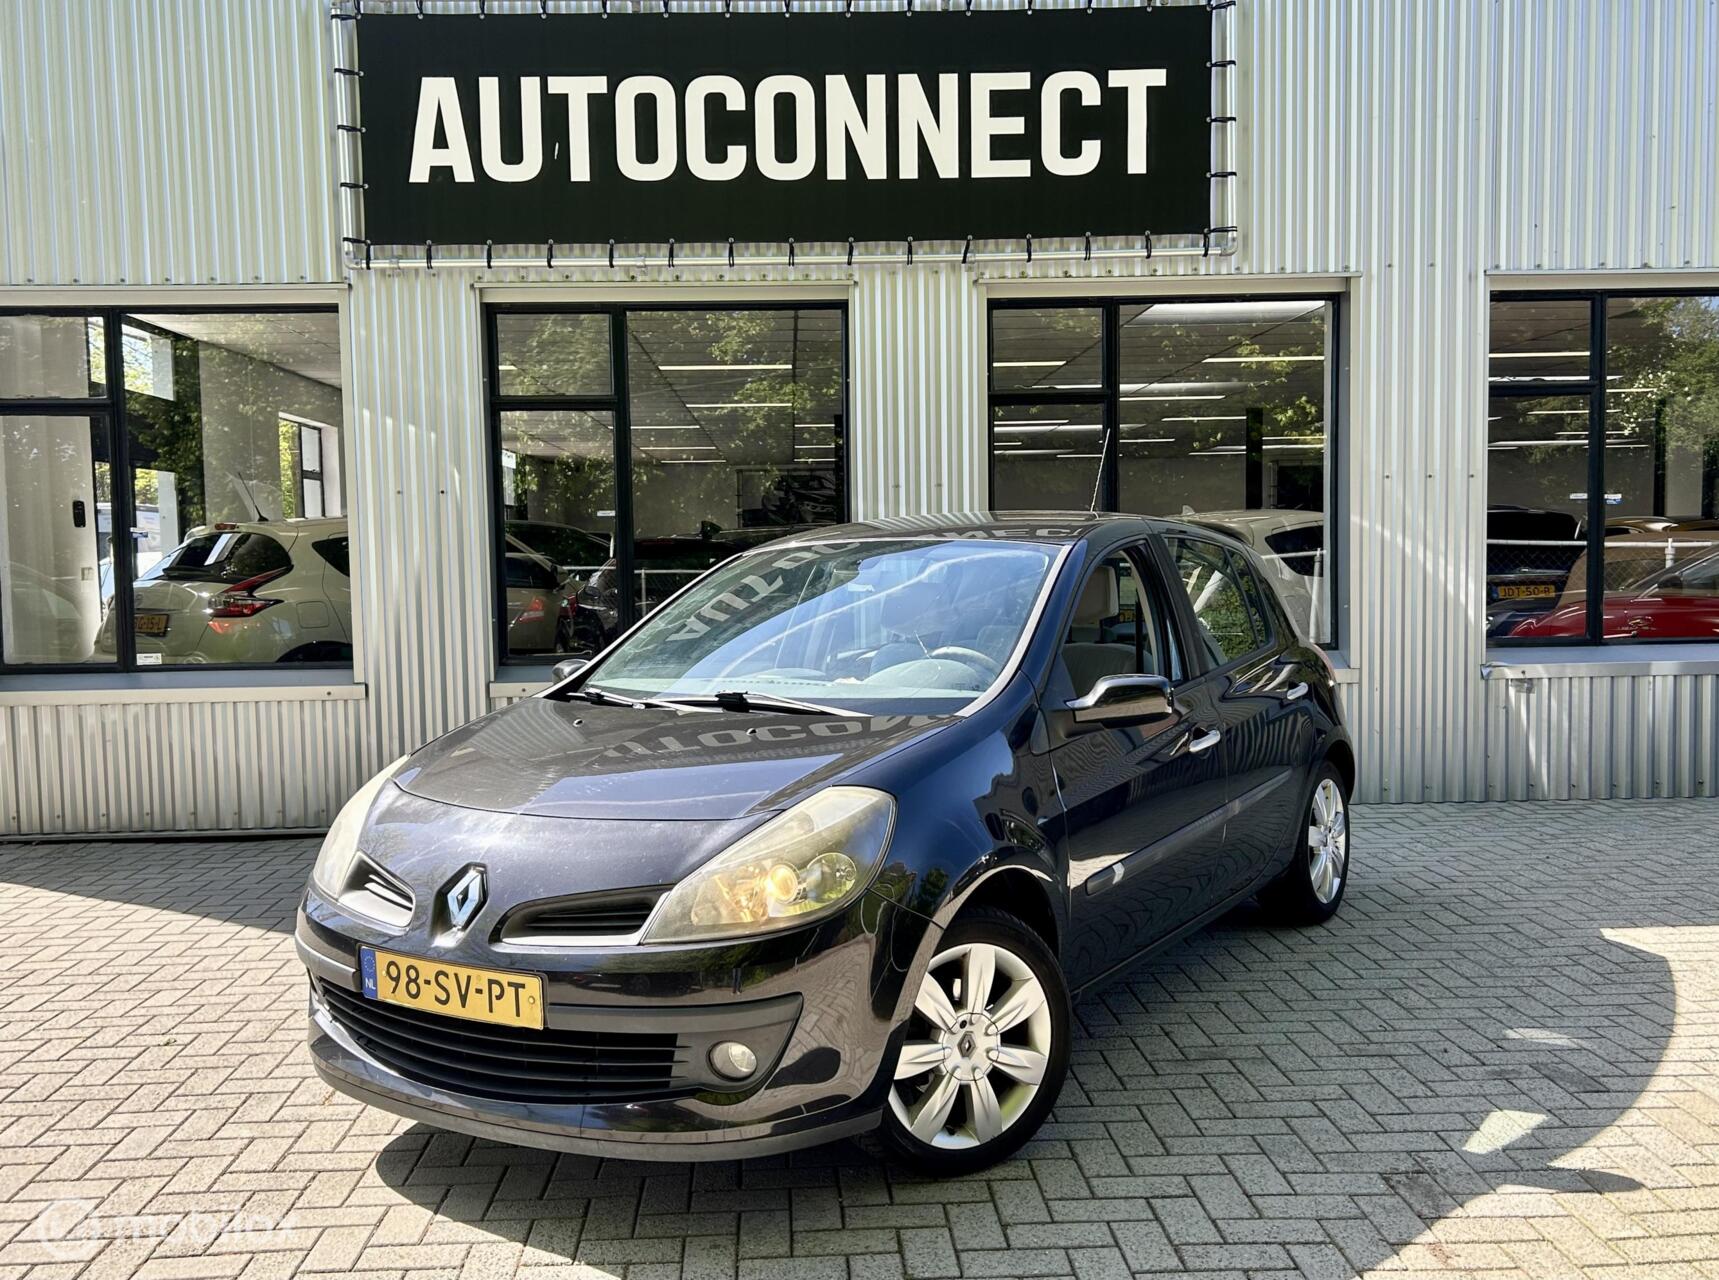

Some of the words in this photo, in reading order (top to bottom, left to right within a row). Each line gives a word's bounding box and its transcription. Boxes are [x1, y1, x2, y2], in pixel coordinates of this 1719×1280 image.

[408, 68, 1167, 184] AUTOCONNECT
[365, 977, 376, 990] NL
[385, 960, 526, 1018] 98-SV-PT
